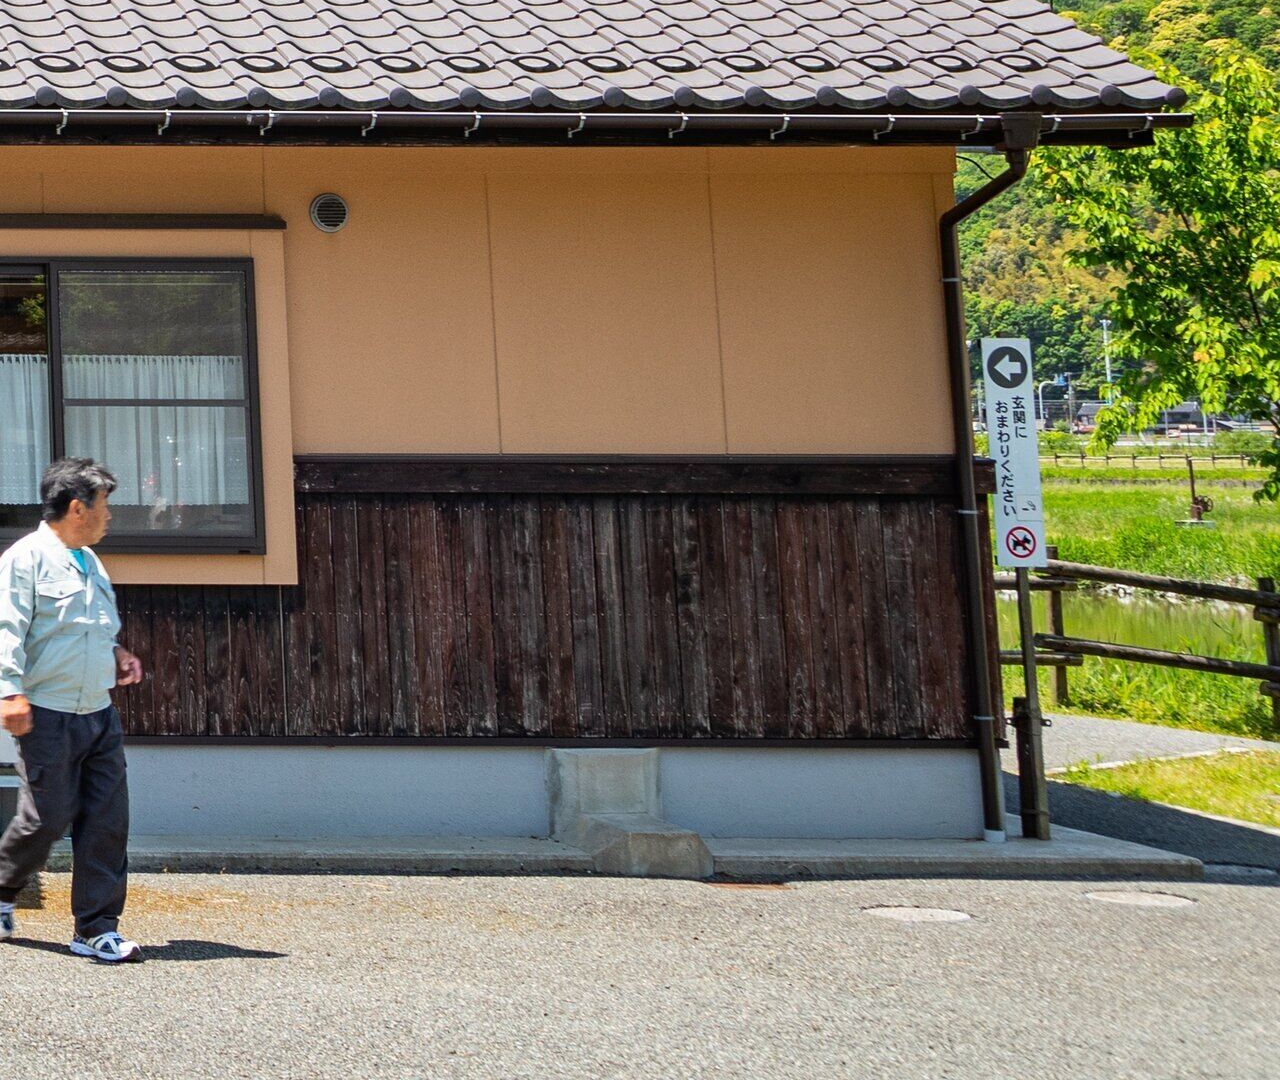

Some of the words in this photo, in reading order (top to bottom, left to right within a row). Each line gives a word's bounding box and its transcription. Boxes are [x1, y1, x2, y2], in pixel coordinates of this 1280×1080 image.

[1011, 395, 1028, 438] 玄関に
[995, 400, 1017, 516] おまわりください
